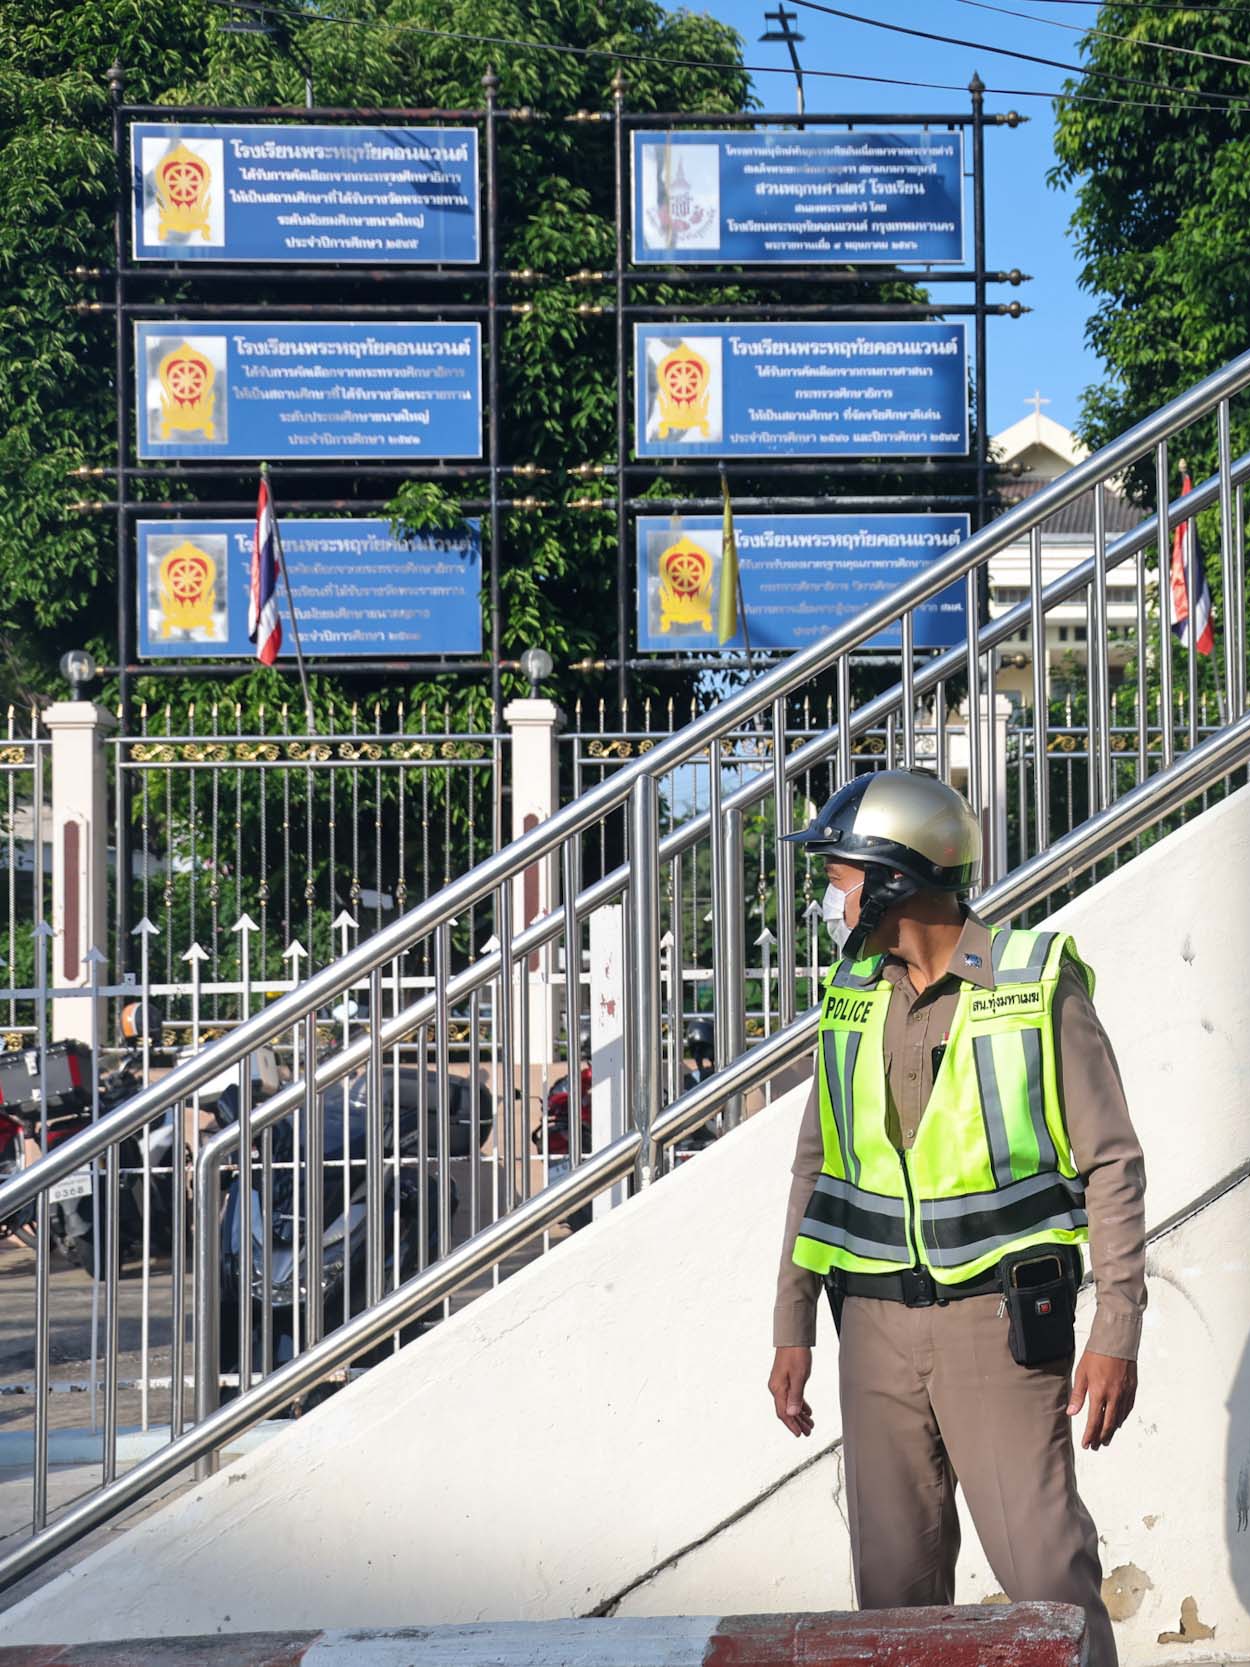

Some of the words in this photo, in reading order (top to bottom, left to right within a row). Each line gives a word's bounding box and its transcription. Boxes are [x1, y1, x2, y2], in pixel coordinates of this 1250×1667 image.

[229, 139, 468, 163] โรงเรียนพระหฤทัยคอนแวนต์
[869, 177, 926, 195] โรงเรียน
[233, 336, 471, 358] โรงเรียนพระหฤทัยคอนแวนต์
[730, 336, 958, 358] โรงเรียนพระหฤทัยคอนแวนต์
[734, 528, 962, 551] โรงเรียนพระหฤทัยคอนแวนต์
[824, 996, 875, 1025] POLICE
[972, 990, 1041, 1014] สน.ทุ่งมหาเมฆ
